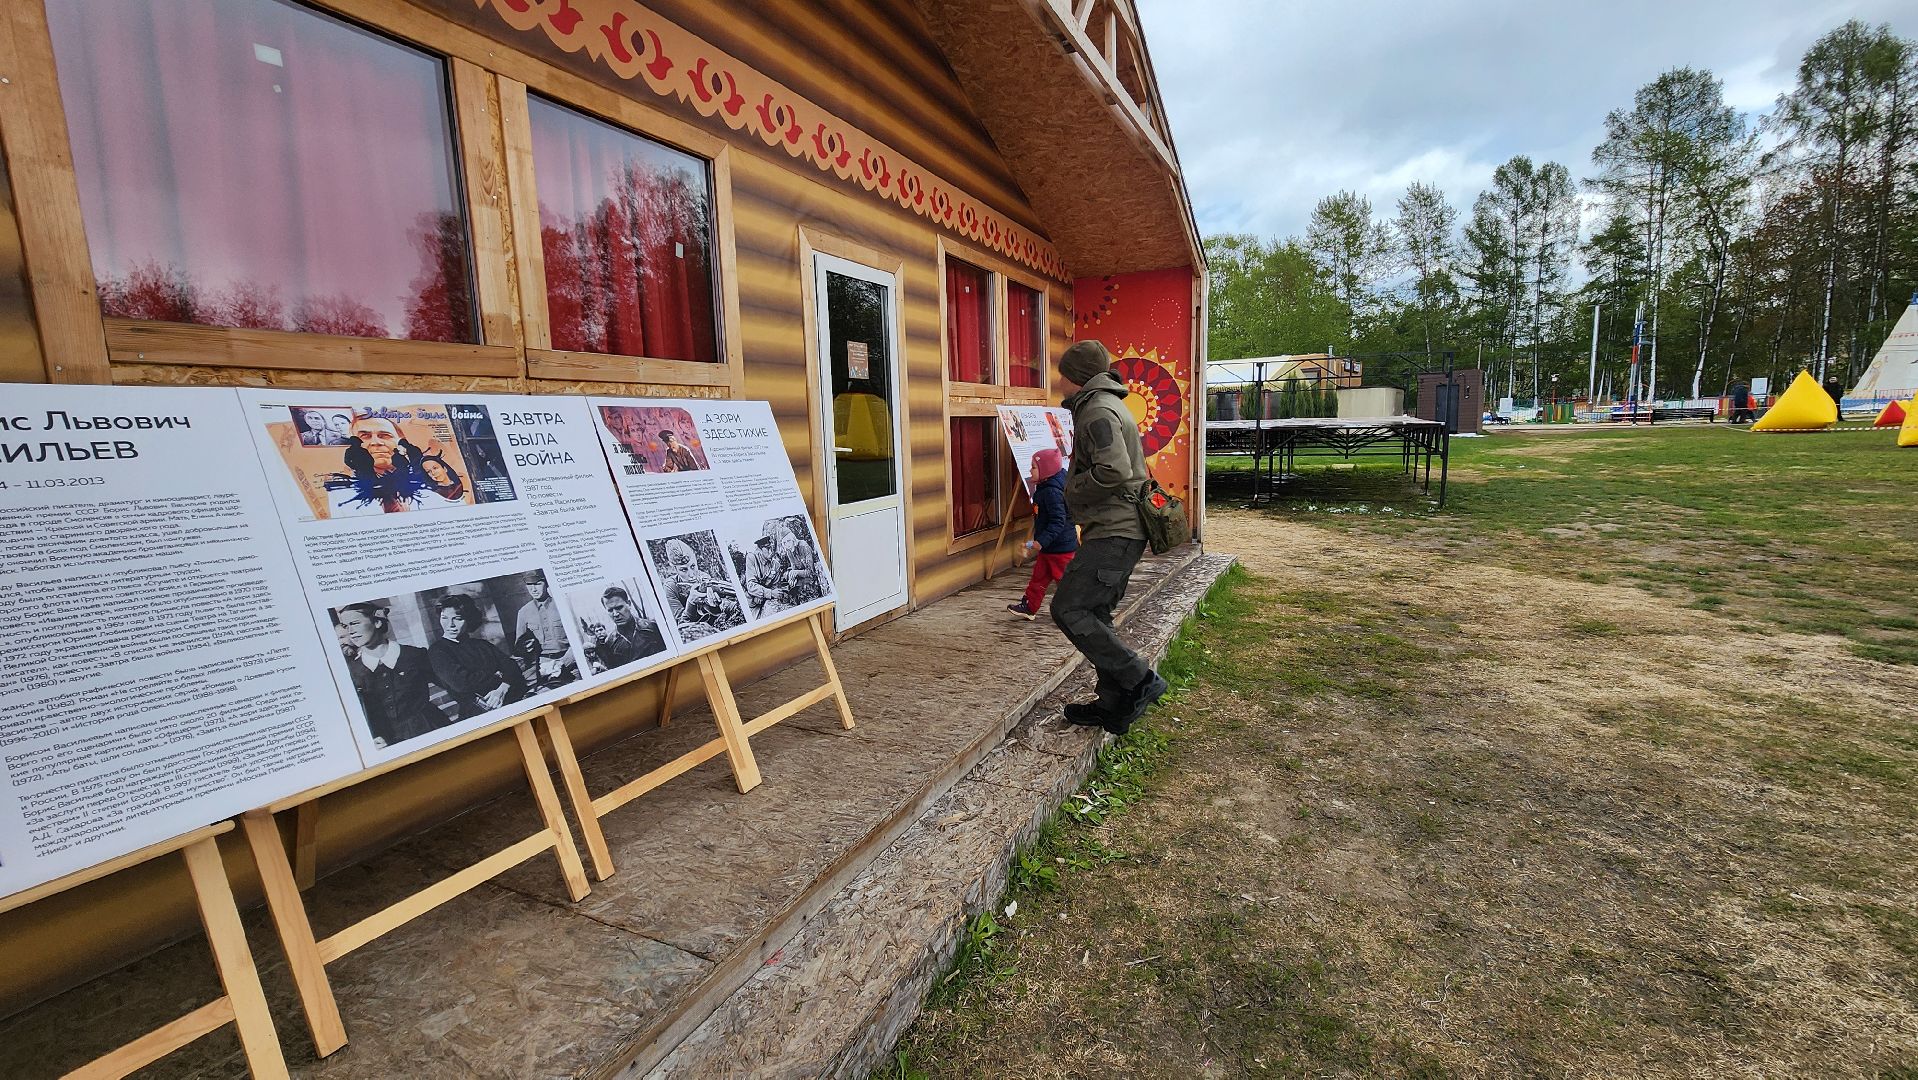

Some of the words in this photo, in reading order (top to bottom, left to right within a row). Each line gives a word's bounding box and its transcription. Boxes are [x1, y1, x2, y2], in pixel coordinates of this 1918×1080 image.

[452, 406, 484, 420] война
[500, 413, 565, 426] ЗАВТРА
[714, 414, 741, 424] ЗОРИ
[43, 410, 191, 431] Львович
[507, 433, 558, 446] БЫЛА
[703, 428, 736, 440] ЗДЕСЬ
[736, 428, 768, 438] ТИХИЕ
[0, 441, 139, 463] ИЛЬЕВ
[514, 450, 575, 466] ВОЙНА
[26, 476, 105, 489] 11.03.2013
